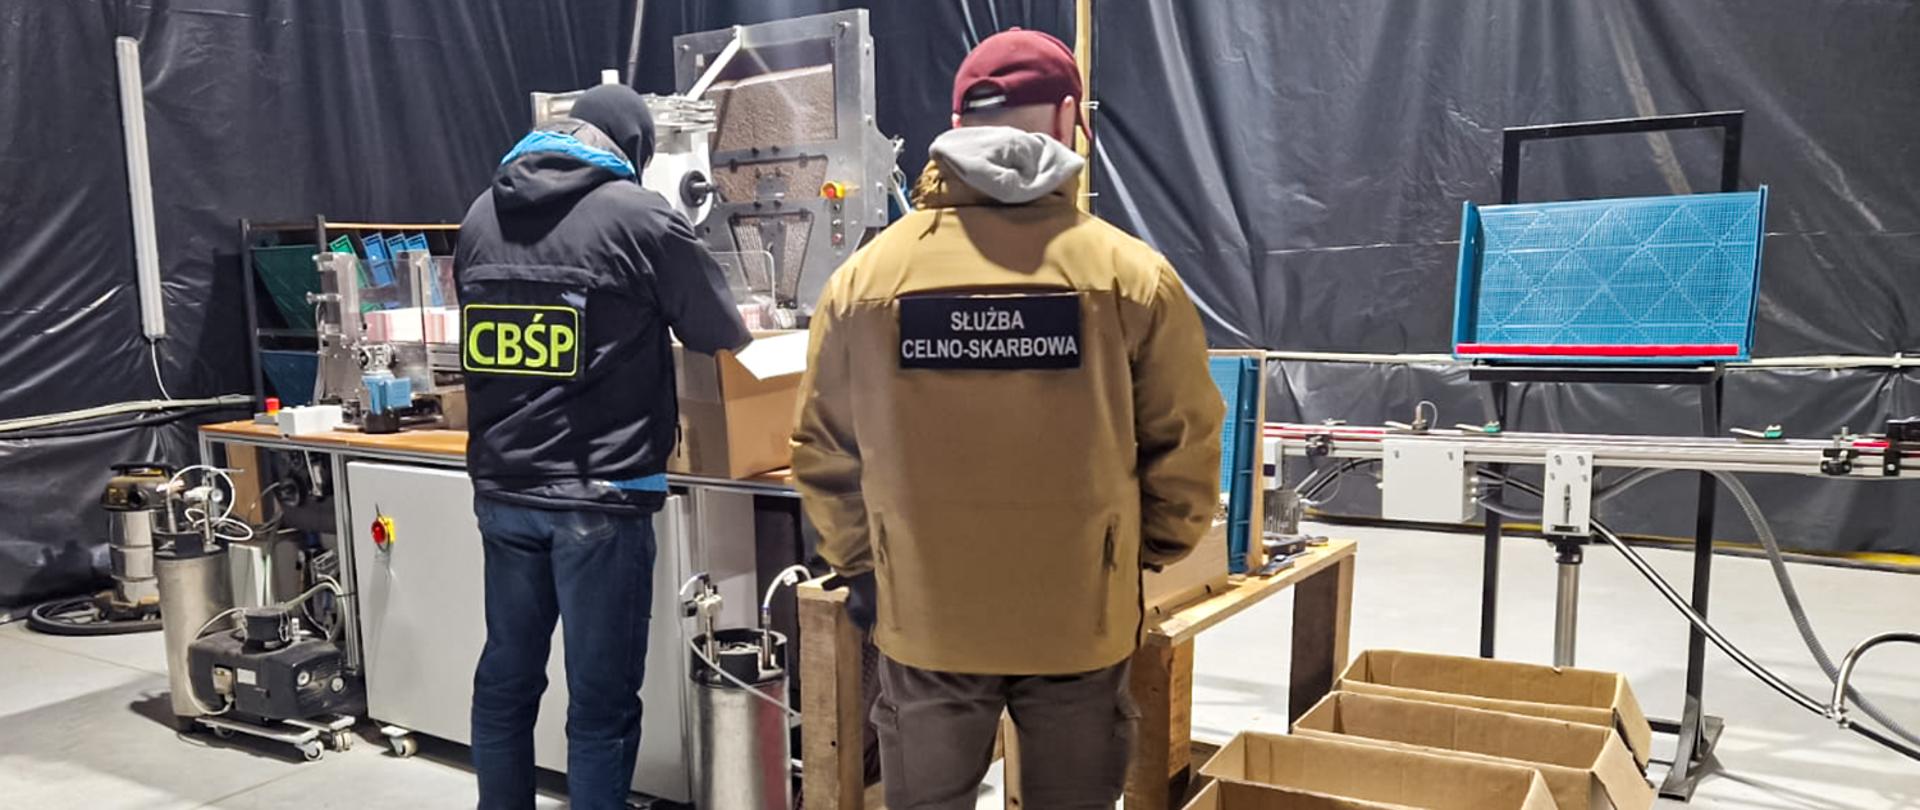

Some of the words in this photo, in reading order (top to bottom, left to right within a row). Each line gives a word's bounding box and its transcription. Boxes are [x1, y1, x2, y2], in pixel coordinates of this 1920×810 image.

[950, 306, 1024, 331] SŁUŻBA
[469, 313, 574, 368] CBŚP
[902, 335, 1078, 359] CELNO-SKARBOWA
